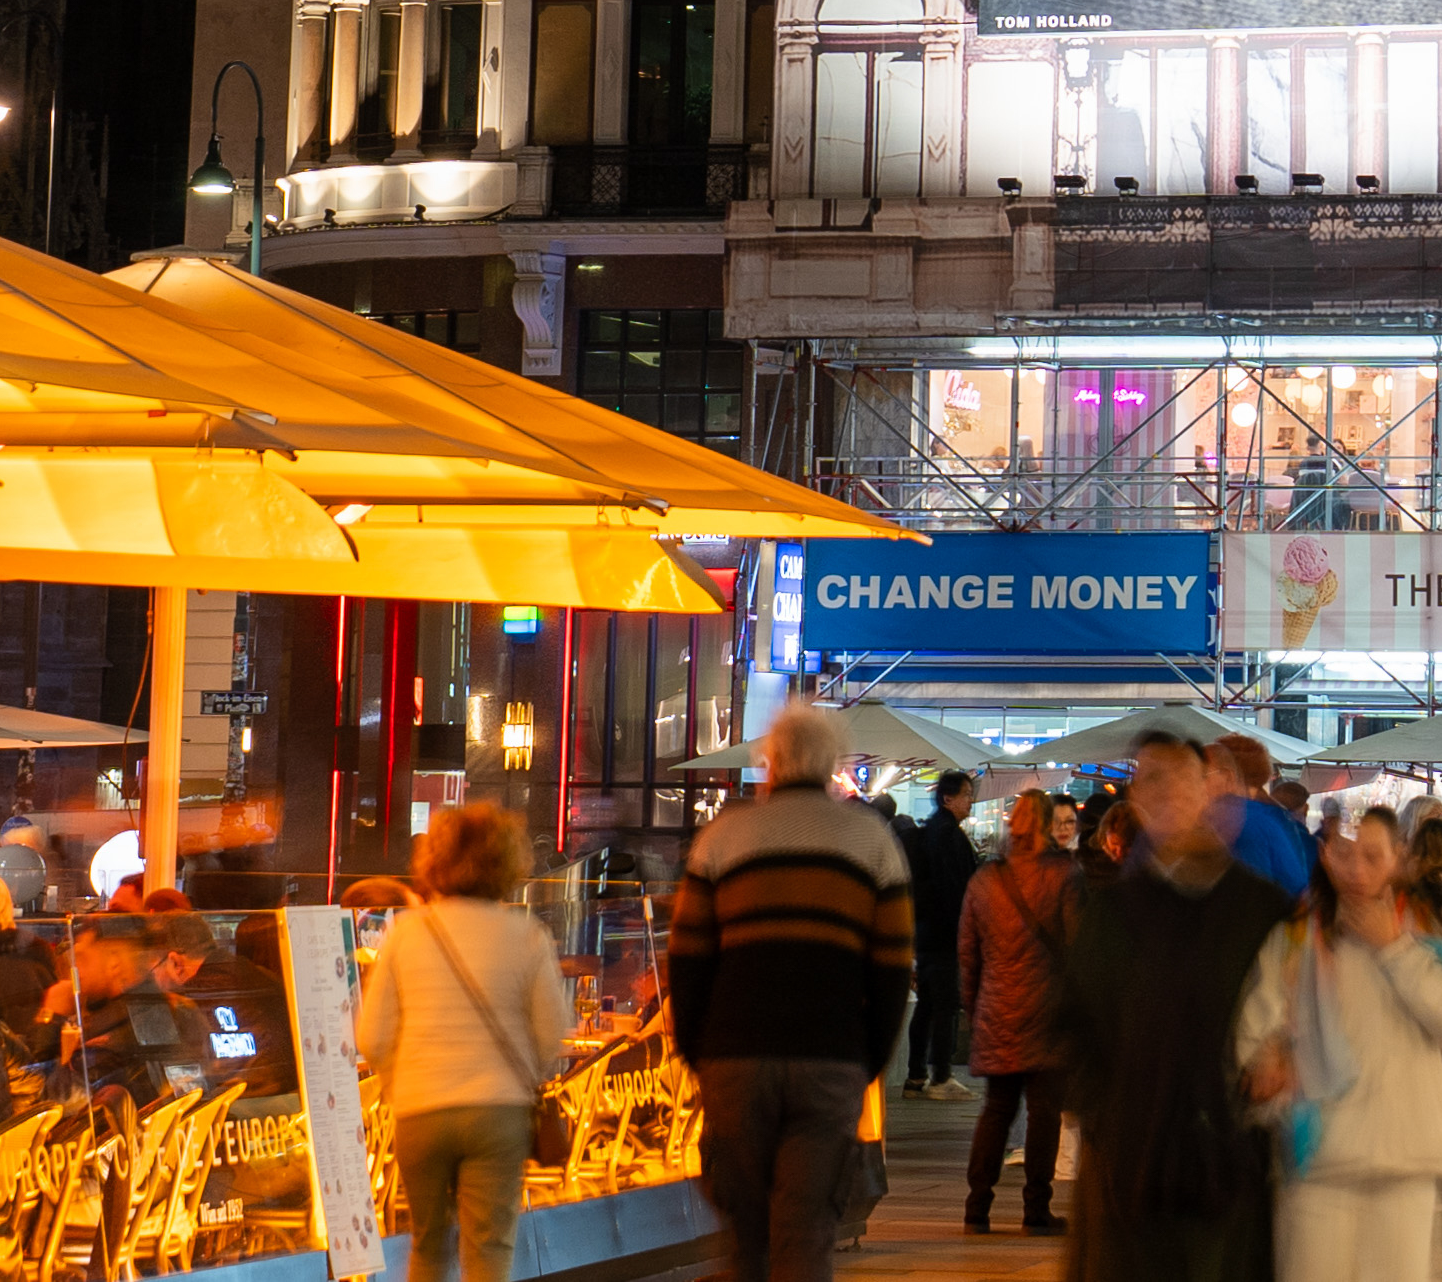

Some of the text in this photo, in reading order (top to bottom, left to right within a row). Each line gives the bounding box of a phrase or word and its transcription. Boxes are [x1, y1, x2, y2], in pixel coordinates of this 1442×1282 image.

[995, 15, 1112, 28] TOM HOLLAND
[816, 575, 1198, 610] CHANGE MONEY
